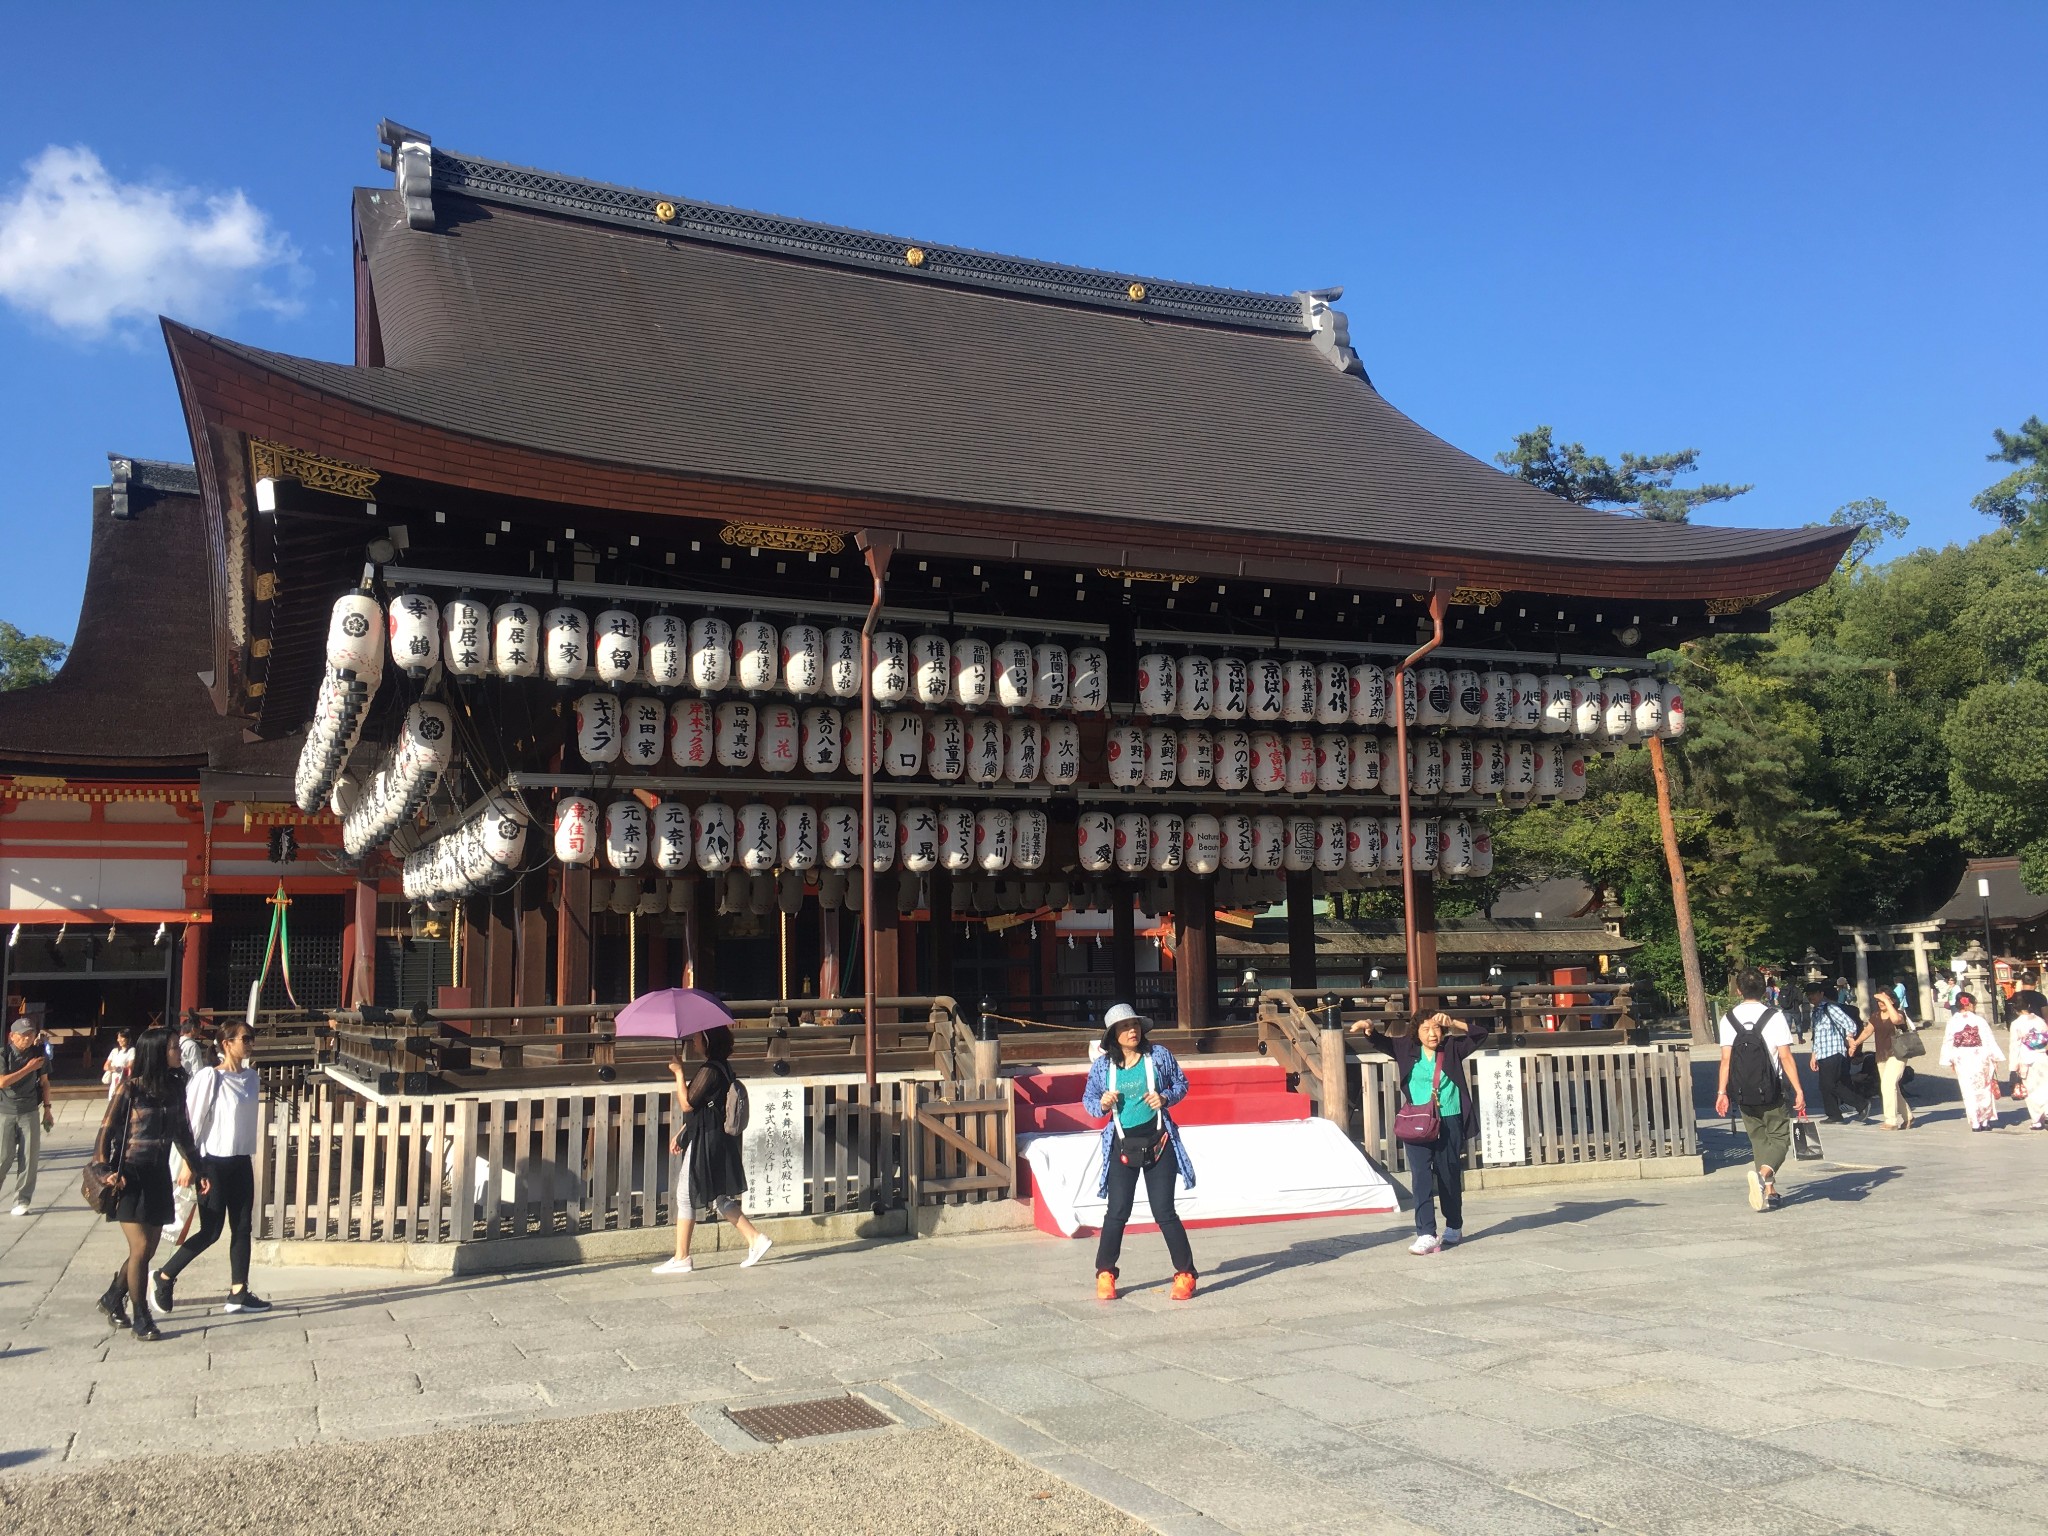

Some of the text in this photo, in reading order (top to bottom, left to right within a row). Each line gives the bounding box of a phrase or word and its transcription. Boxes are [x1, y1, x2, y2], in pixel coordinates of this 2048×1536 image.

[408, 598, 430, 656] 孝鶴
[457, 604, 480, 666] 鳥居本
[558, 613, 582, 663] 湊家
[610, 618, 632, 670] 辻留
[886, 637, 904, 691] 権兵衛
[926, 640, 947, 696] 権兵衛
[1159, 656, 1174, 706] 美濃幸
[1368, 666, 1384, 719] 八木源太郎
[1523, 690, 1541, 722] 畑中
[1553, 690, 1571, 722] 畑中
[1612, 693, 1631, 723] 畑中
[1644, 690, 1662, 723] 畑中
[590, 697, 612, 750] キメラ
[638, 706, 656, 758] 池田家
[773, 712, 792, 758] 豆花
[817, 710, 835, 764] 美の八重
[900, 717, 917, 767] 川口
[1129, 730, 1143, 781] 矢野一郎
[1159, 733, 1174, 782] 矢野一郎
[1197, 733, 1211, 781] 矢野一郎
[1233, 733, 1248, 782] みの家
[622, 805, 641, 863] 元奈古
[665, 808, 685, 865] 元奈古
[875, 814, 890, 837] 北尾
[956, 813, 972, 864] 花さくら
[764, 1102, 776, 1207] 挙式をお受けします
[781, 1088, 793, 1205] 本殿・舞殿・儀式殿にて
